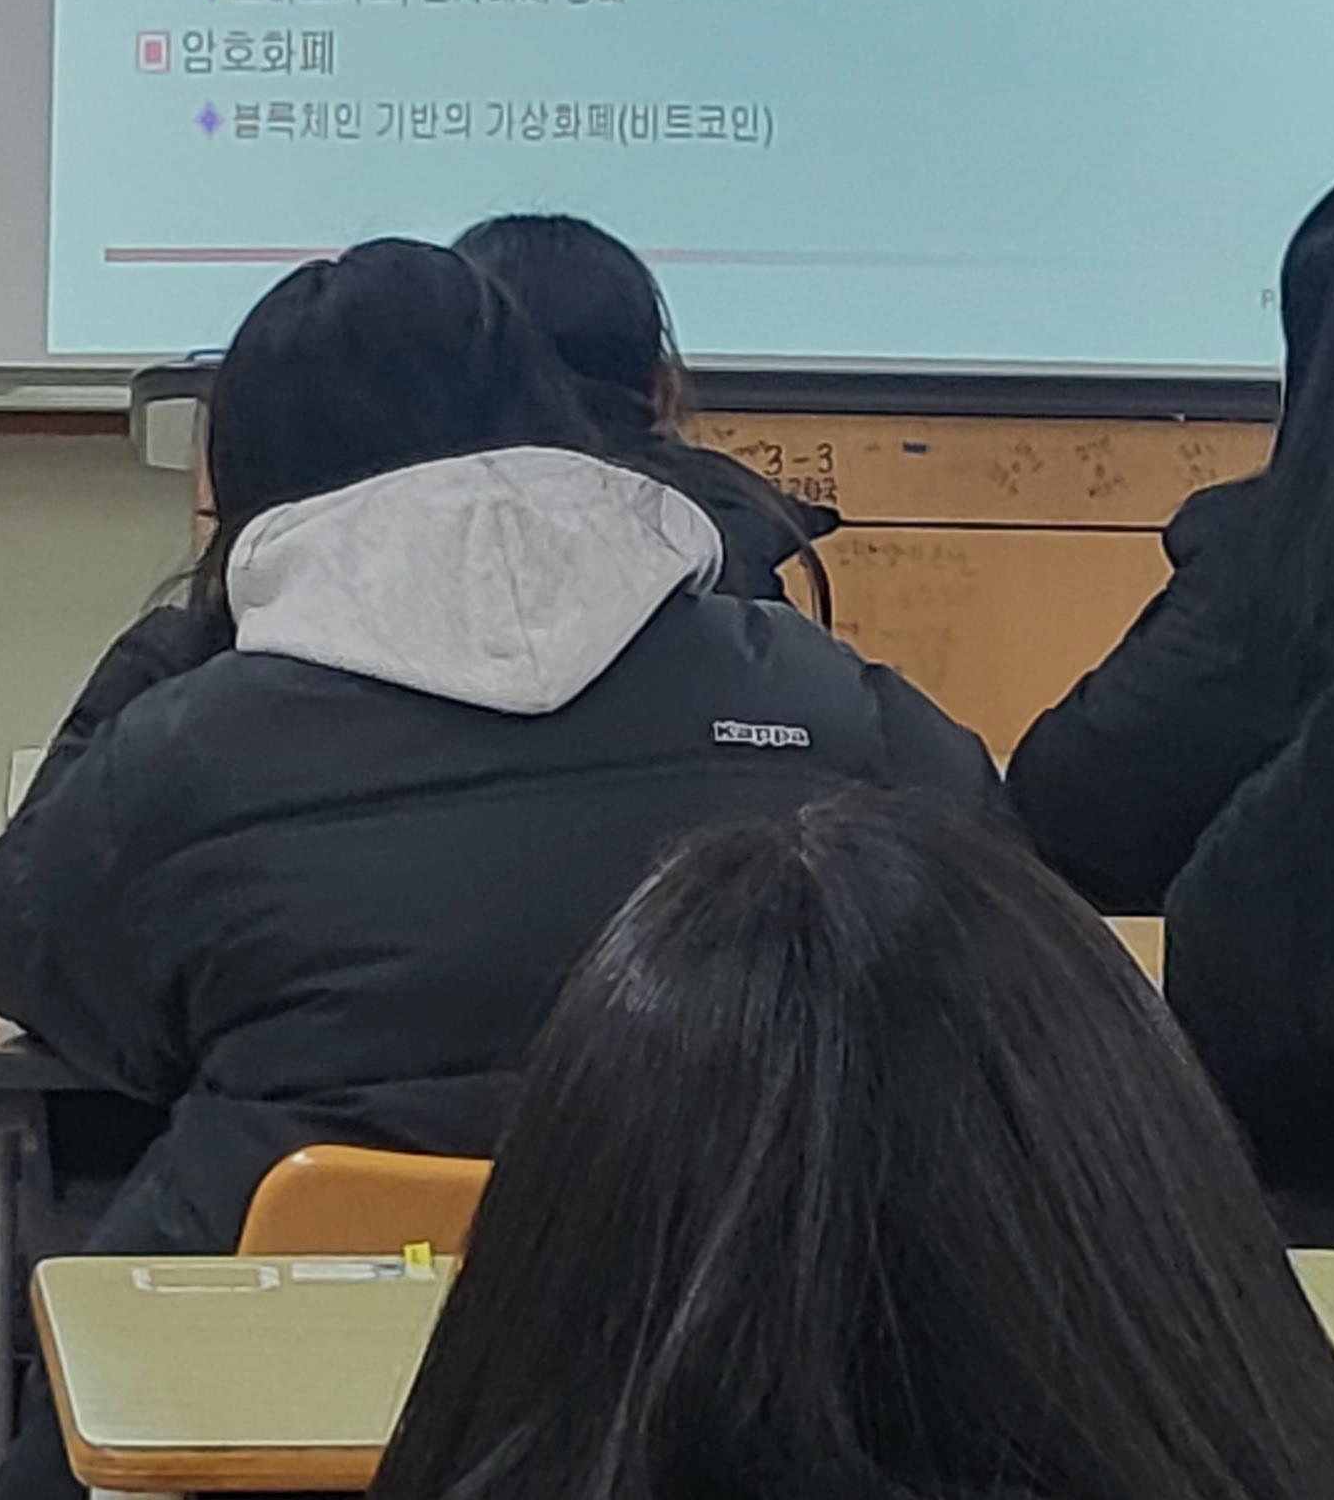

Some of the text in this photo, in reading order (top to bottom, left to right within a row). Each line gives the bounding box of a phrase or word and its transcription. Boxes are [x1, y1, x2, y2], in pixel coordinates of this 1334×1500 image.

[182, 29, 336, 74] 암호화폐
[233, 102, 774, 149] 블록체인 기반의 가상화폐(비트코인)
[713, 721, 810, 747] Kappa
